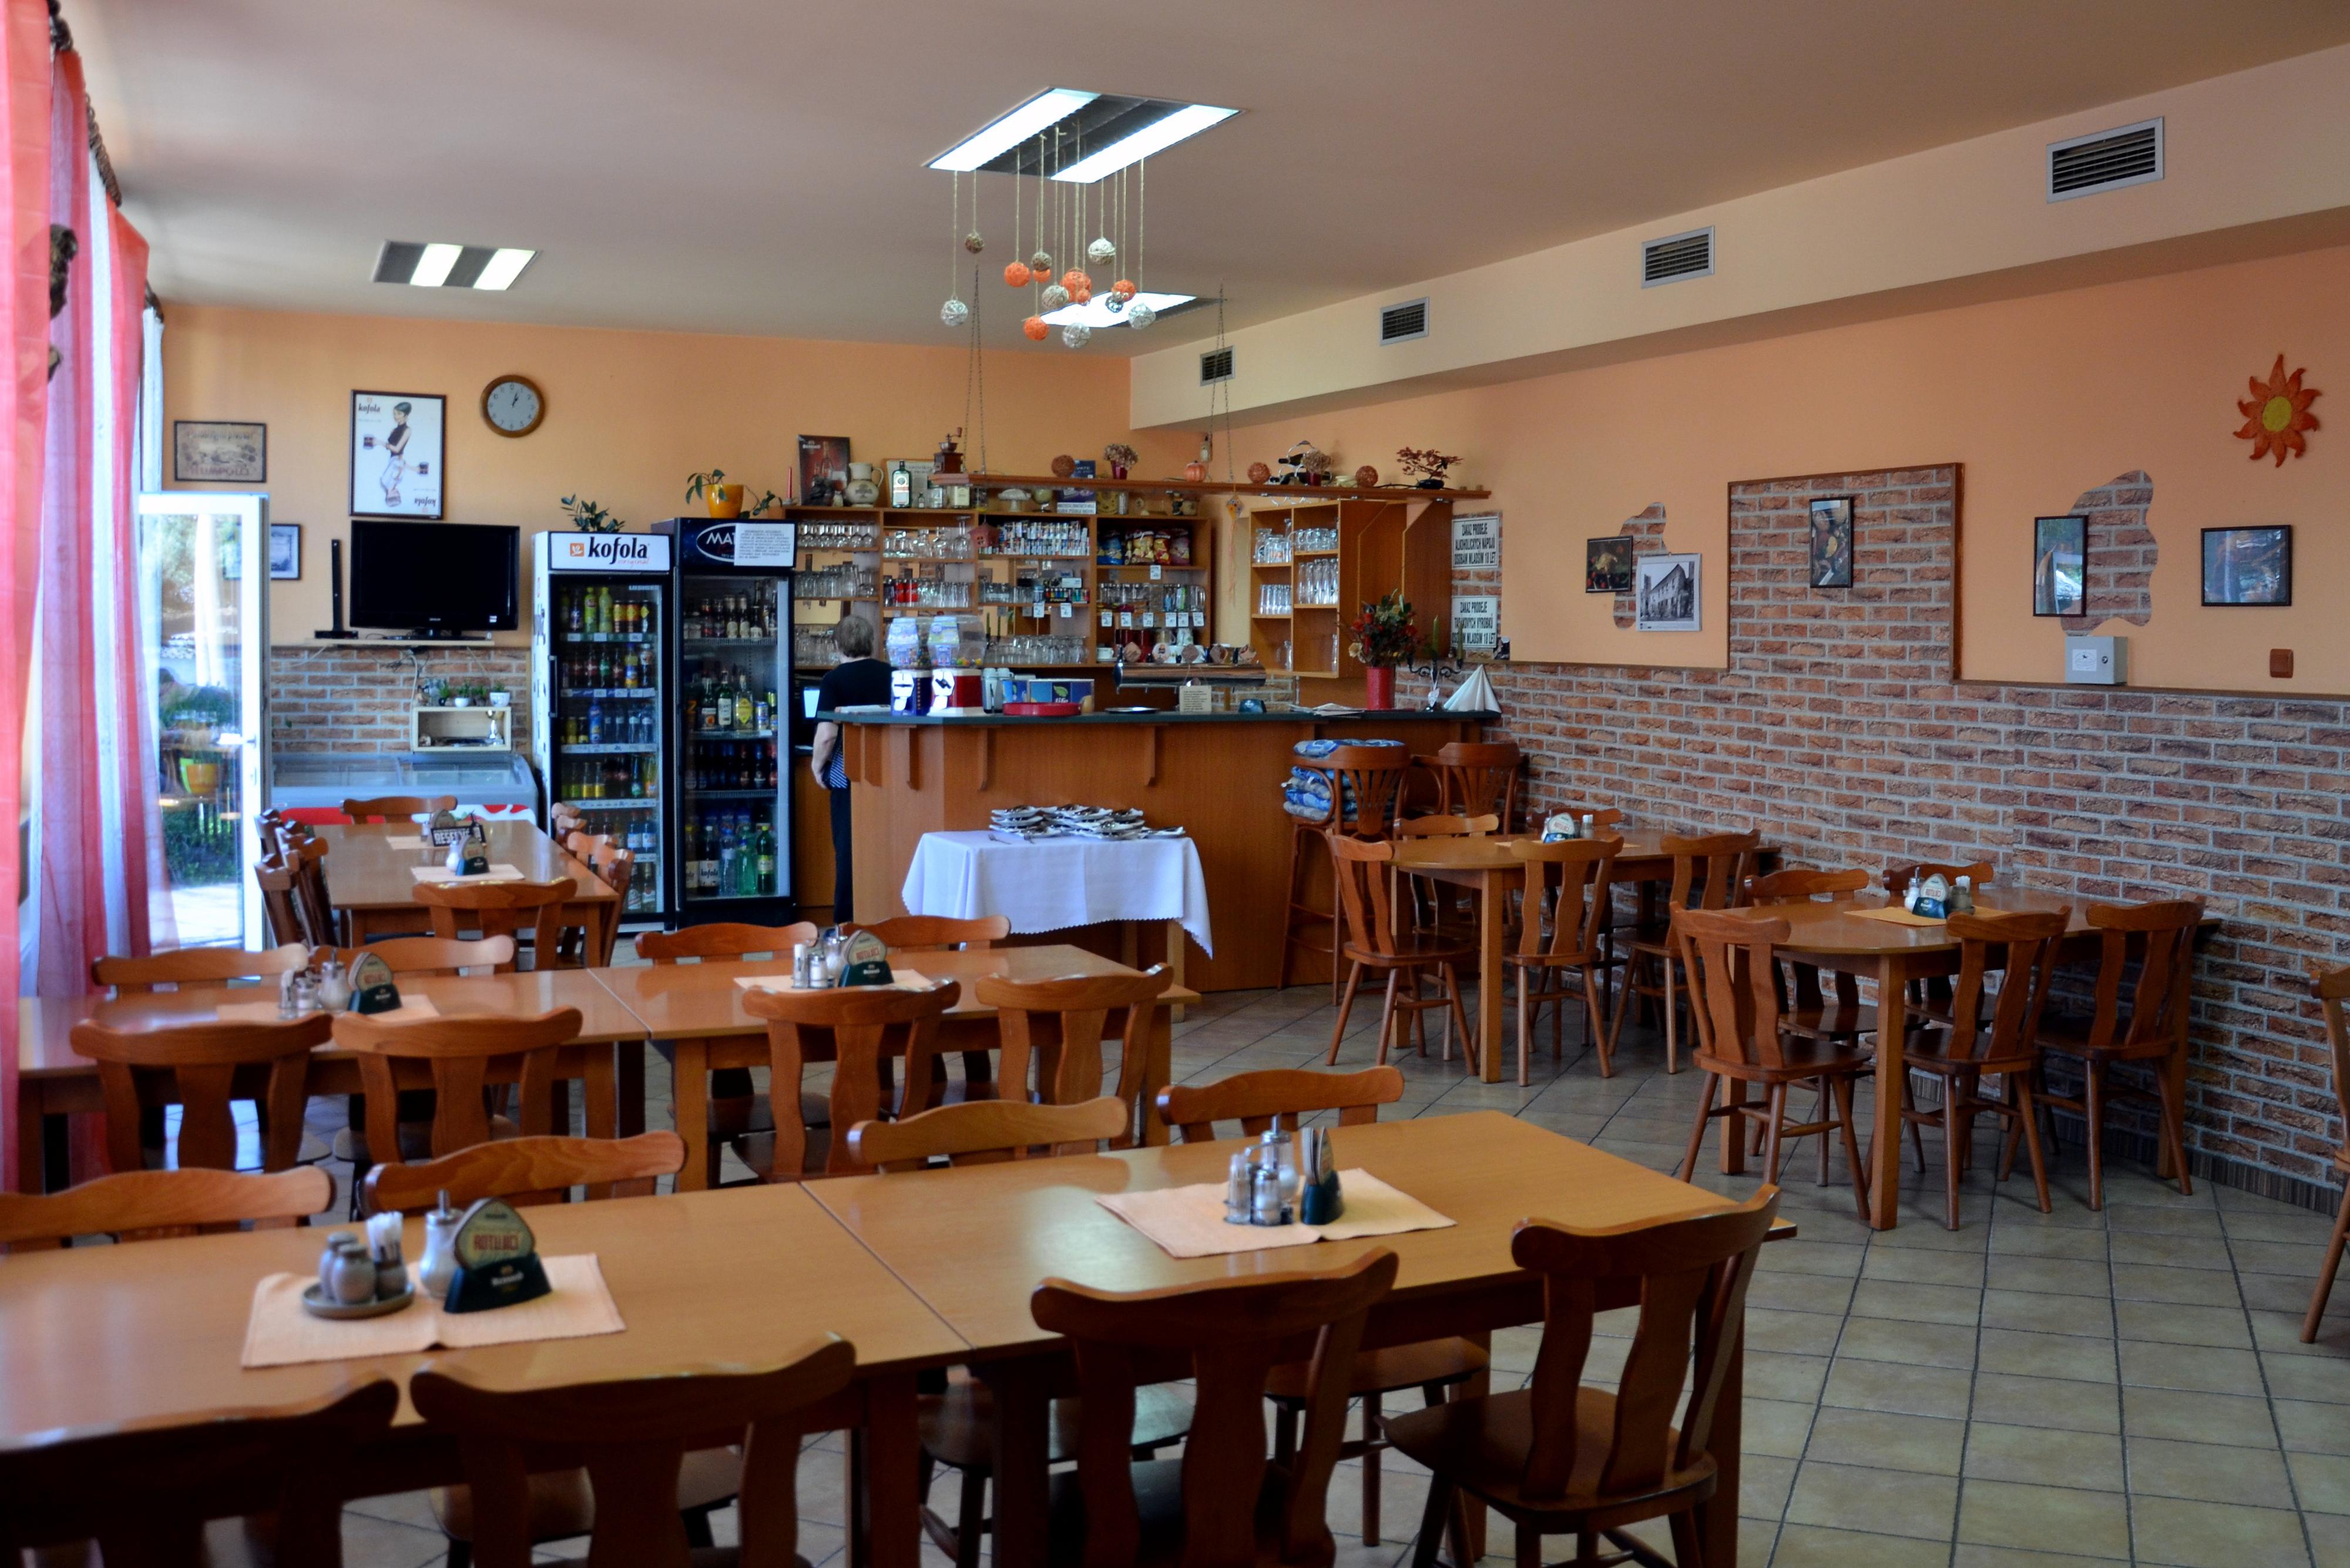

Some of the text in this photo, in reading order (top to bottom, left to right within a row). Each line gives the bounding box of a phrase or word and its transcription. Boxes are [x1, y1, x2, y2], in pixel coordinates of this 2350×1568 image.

[358, 402, 381, 414] kofola
[414, 496, 437, 507] kofola
[1472, 522, 1488, 535] PRODEJE
[588, 536, 648, 565] kofola
[1471, 601, 1488, 613] PRODEJE
